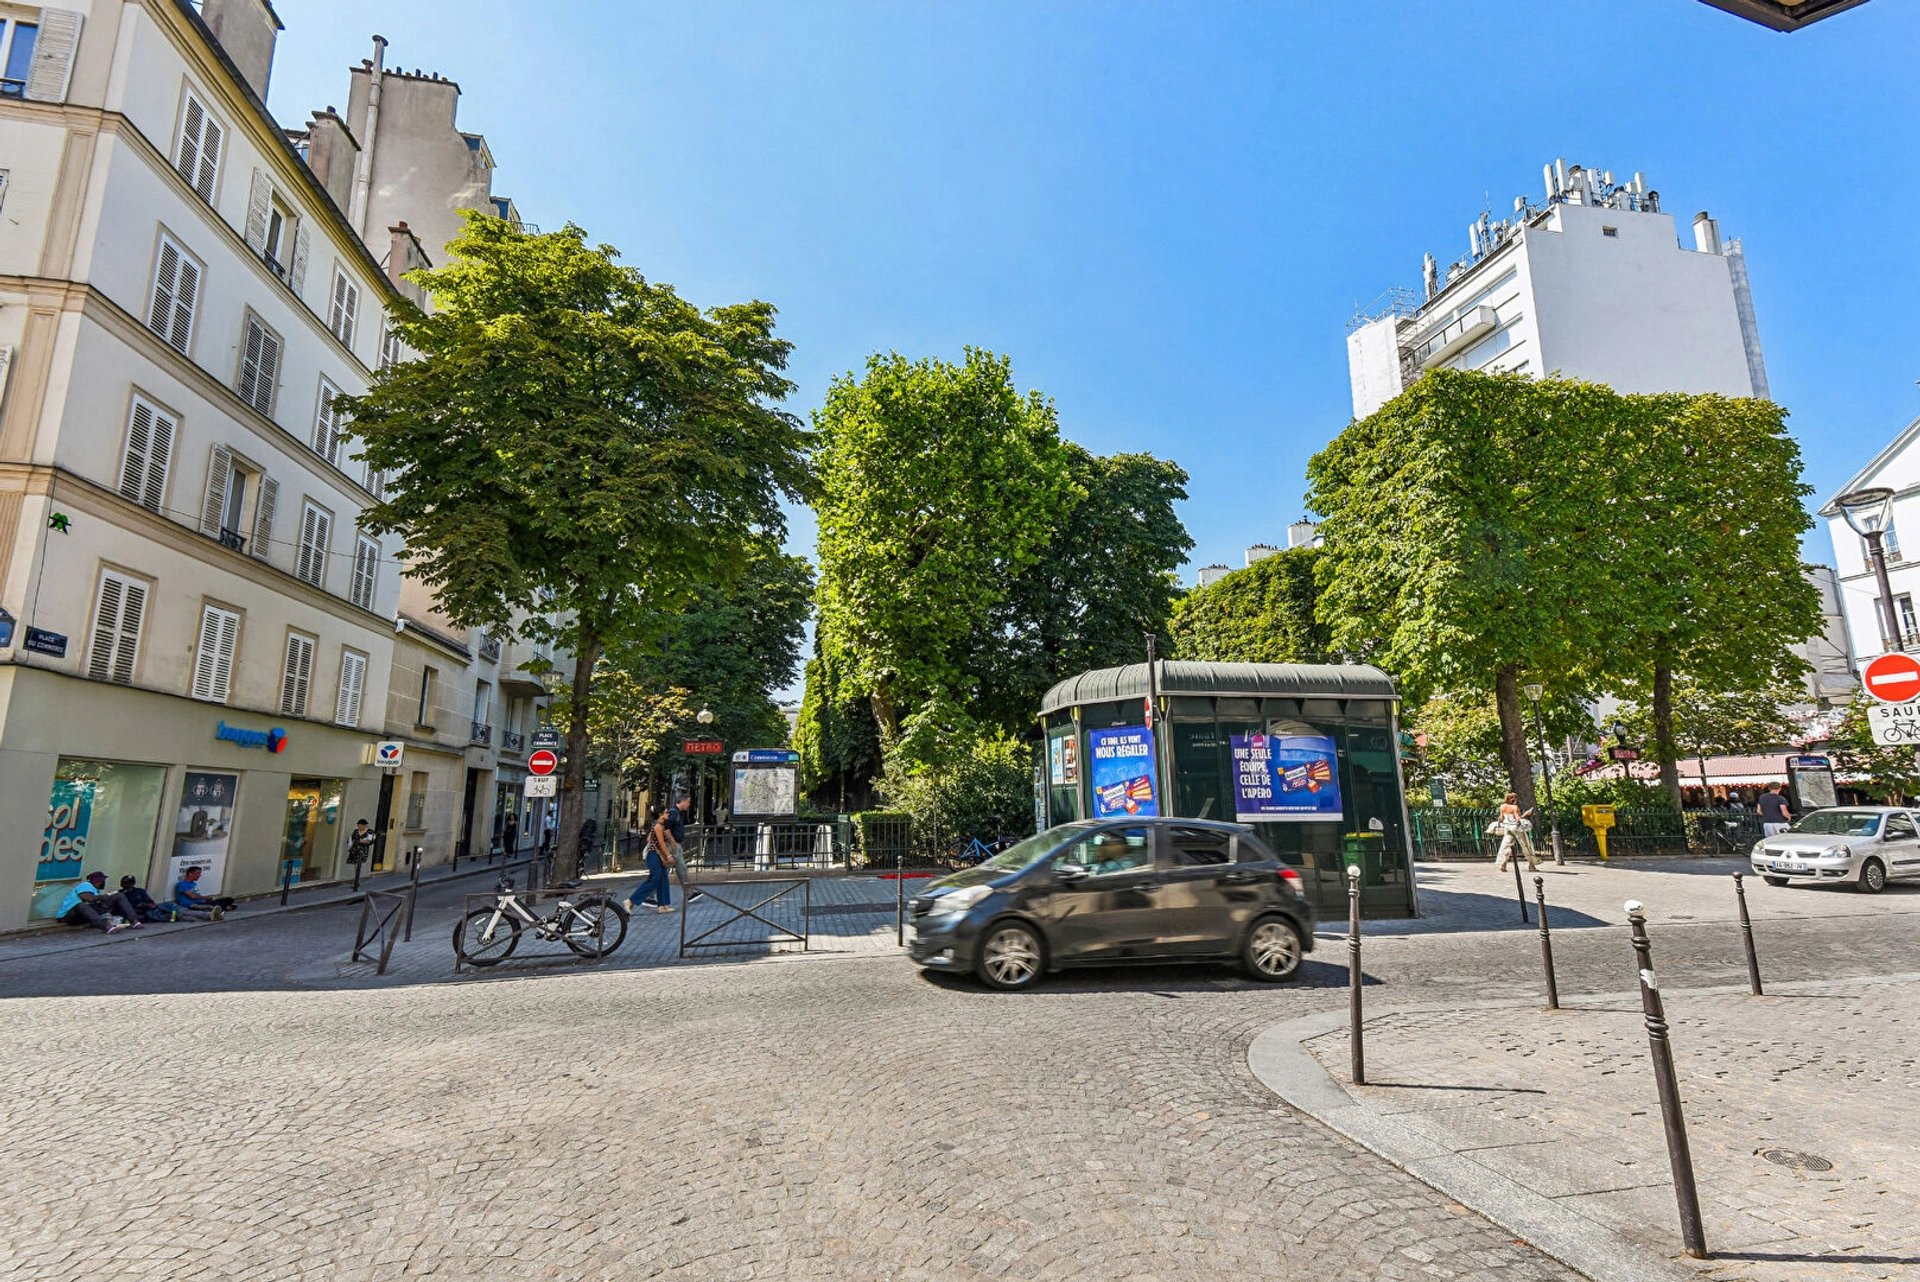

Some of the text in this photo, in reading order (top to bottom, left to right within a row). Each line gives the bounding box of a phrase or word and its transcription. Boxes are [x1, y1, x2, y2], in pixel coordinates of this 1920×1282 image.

[1095, 743, 1149, 759] NOUS RÉGALER
[1234, 748, 1272, 759] UNE SEULE
[1240, 760, 1269, 773] ÉQUIPE,
[1240, 774, 1271, 786] CELLE DE
[1241, 786, 1272, 799] L'APÉRO
[39, 829, 87, 863] des
